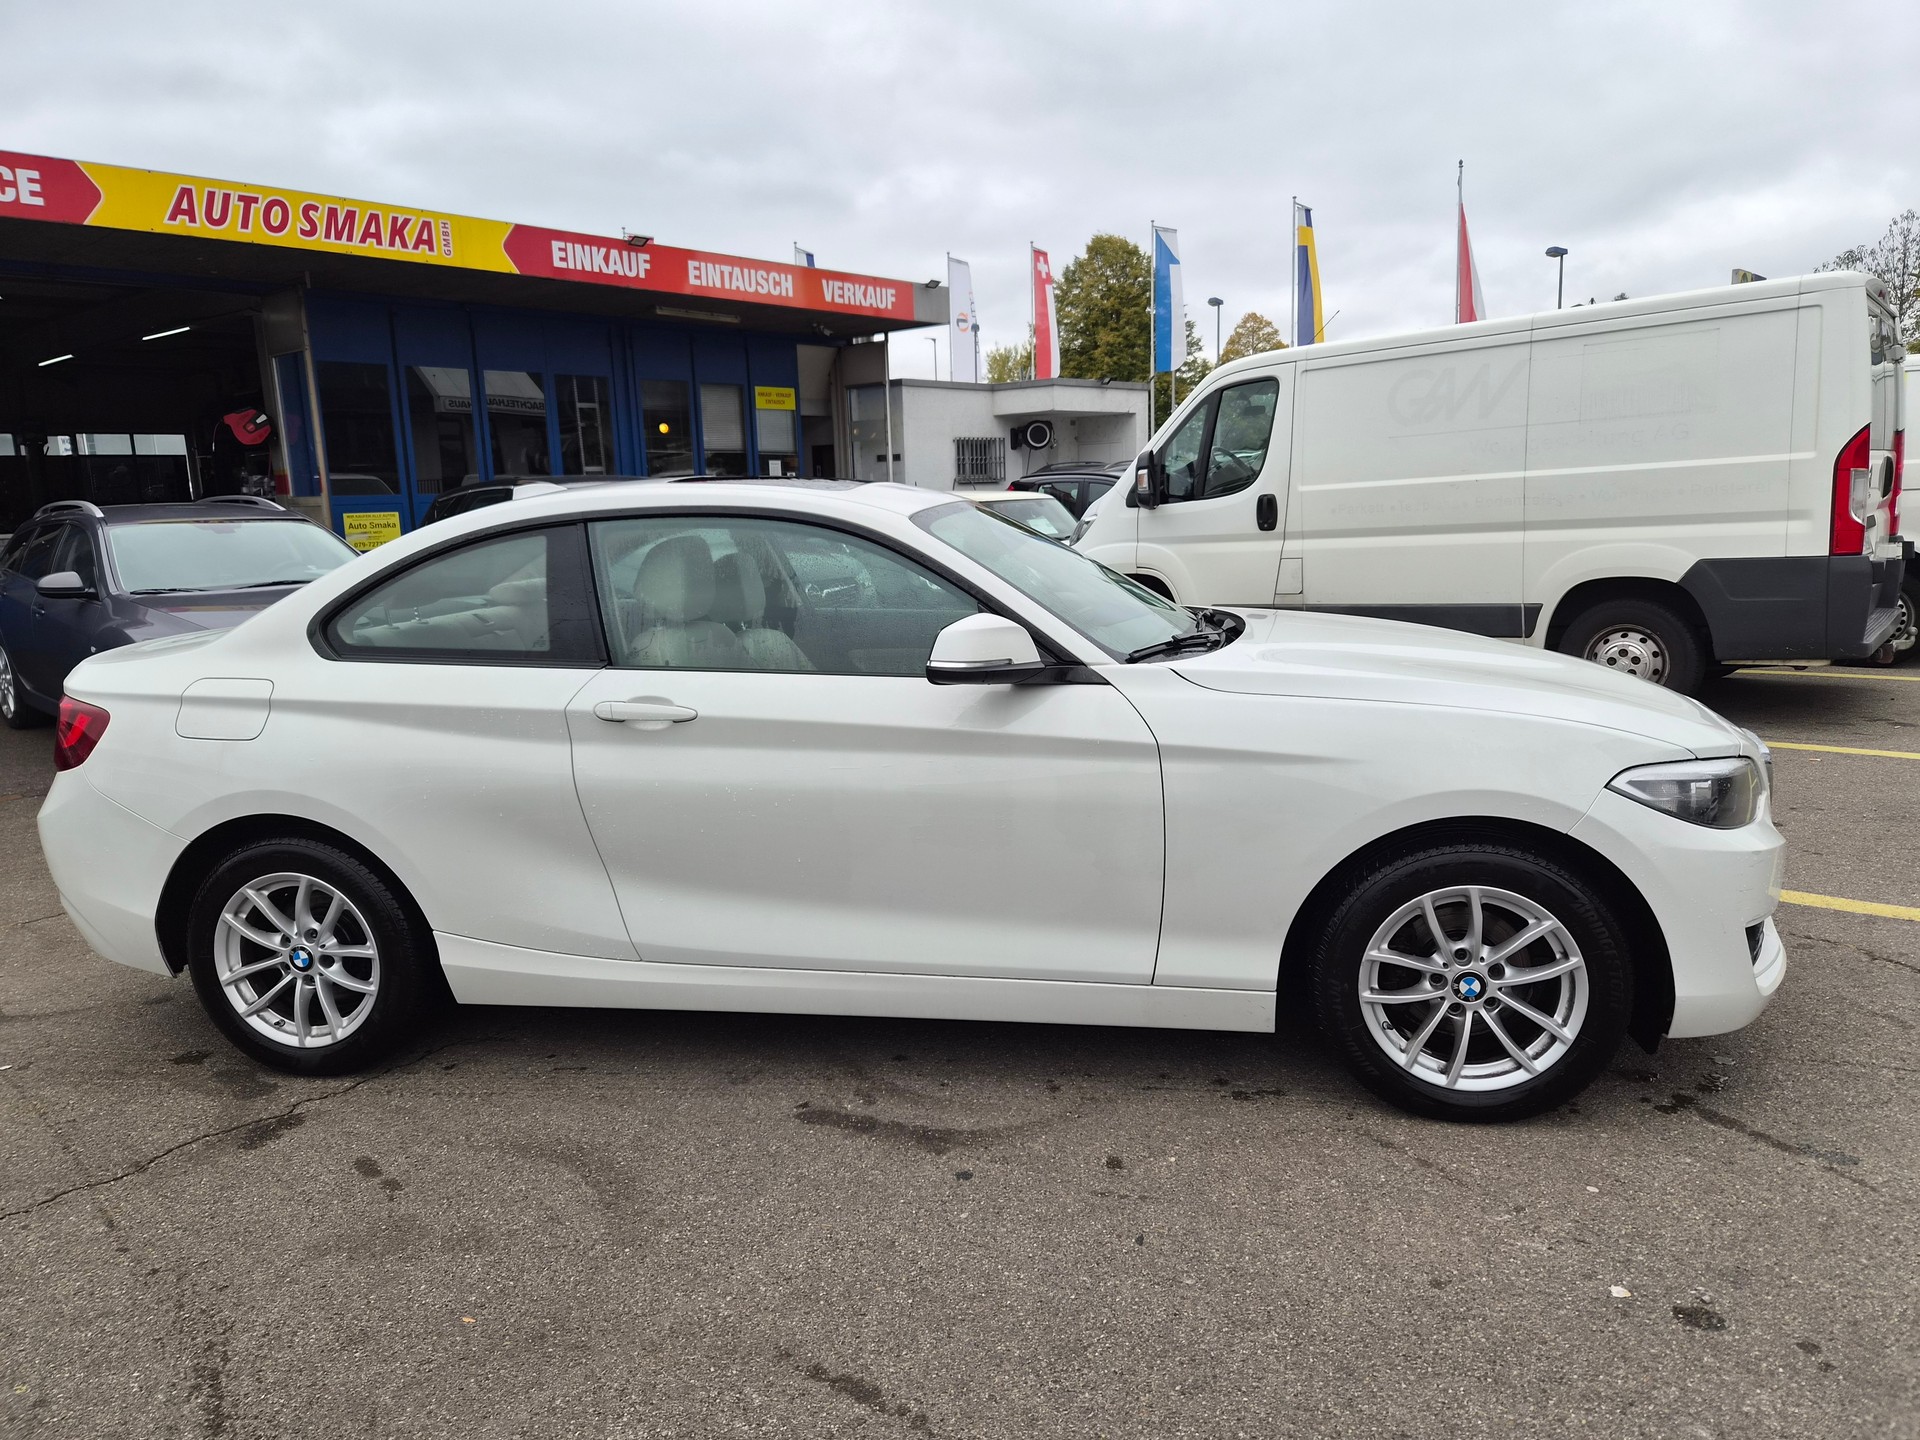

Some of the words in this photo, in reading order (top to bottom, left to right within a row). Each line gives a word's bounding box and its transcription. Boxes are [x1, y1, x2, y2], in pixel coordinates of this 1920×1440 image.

[165, 185, 290, 235] AUTO
[298, 202, 437, 254] SMAKA
[441, 221, 452, 257] GMBH
[551, 240, 650, 278] EINKAUF
[688, 260, 793, 297] EINTAUSCH
[822, 279, 896, 310] VERKAUF
[369, 521, 397, 529] Smaka
